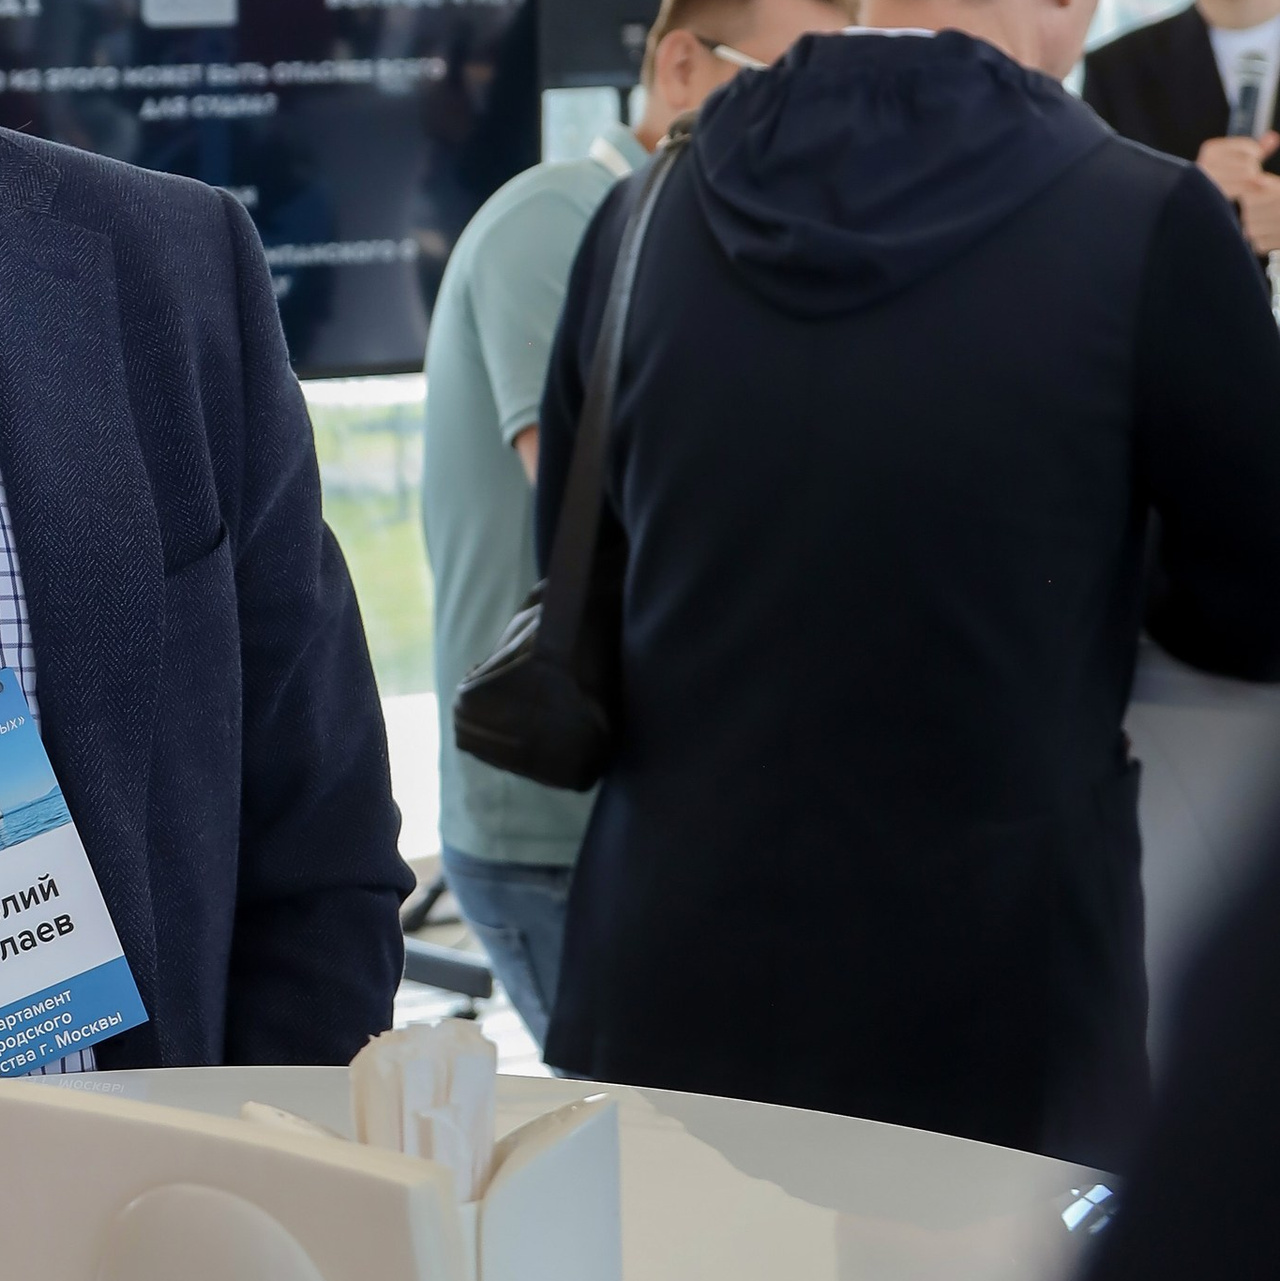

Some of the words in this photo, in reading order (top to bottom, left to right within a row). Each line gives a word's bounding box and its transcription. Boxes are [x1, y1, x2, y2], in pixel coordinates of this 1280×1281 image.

[122, 64, 202, 89] МОЖЕТ
[39, 1042, 54, 1057] г.
[55, 1012, 123, 1049] Москвы
